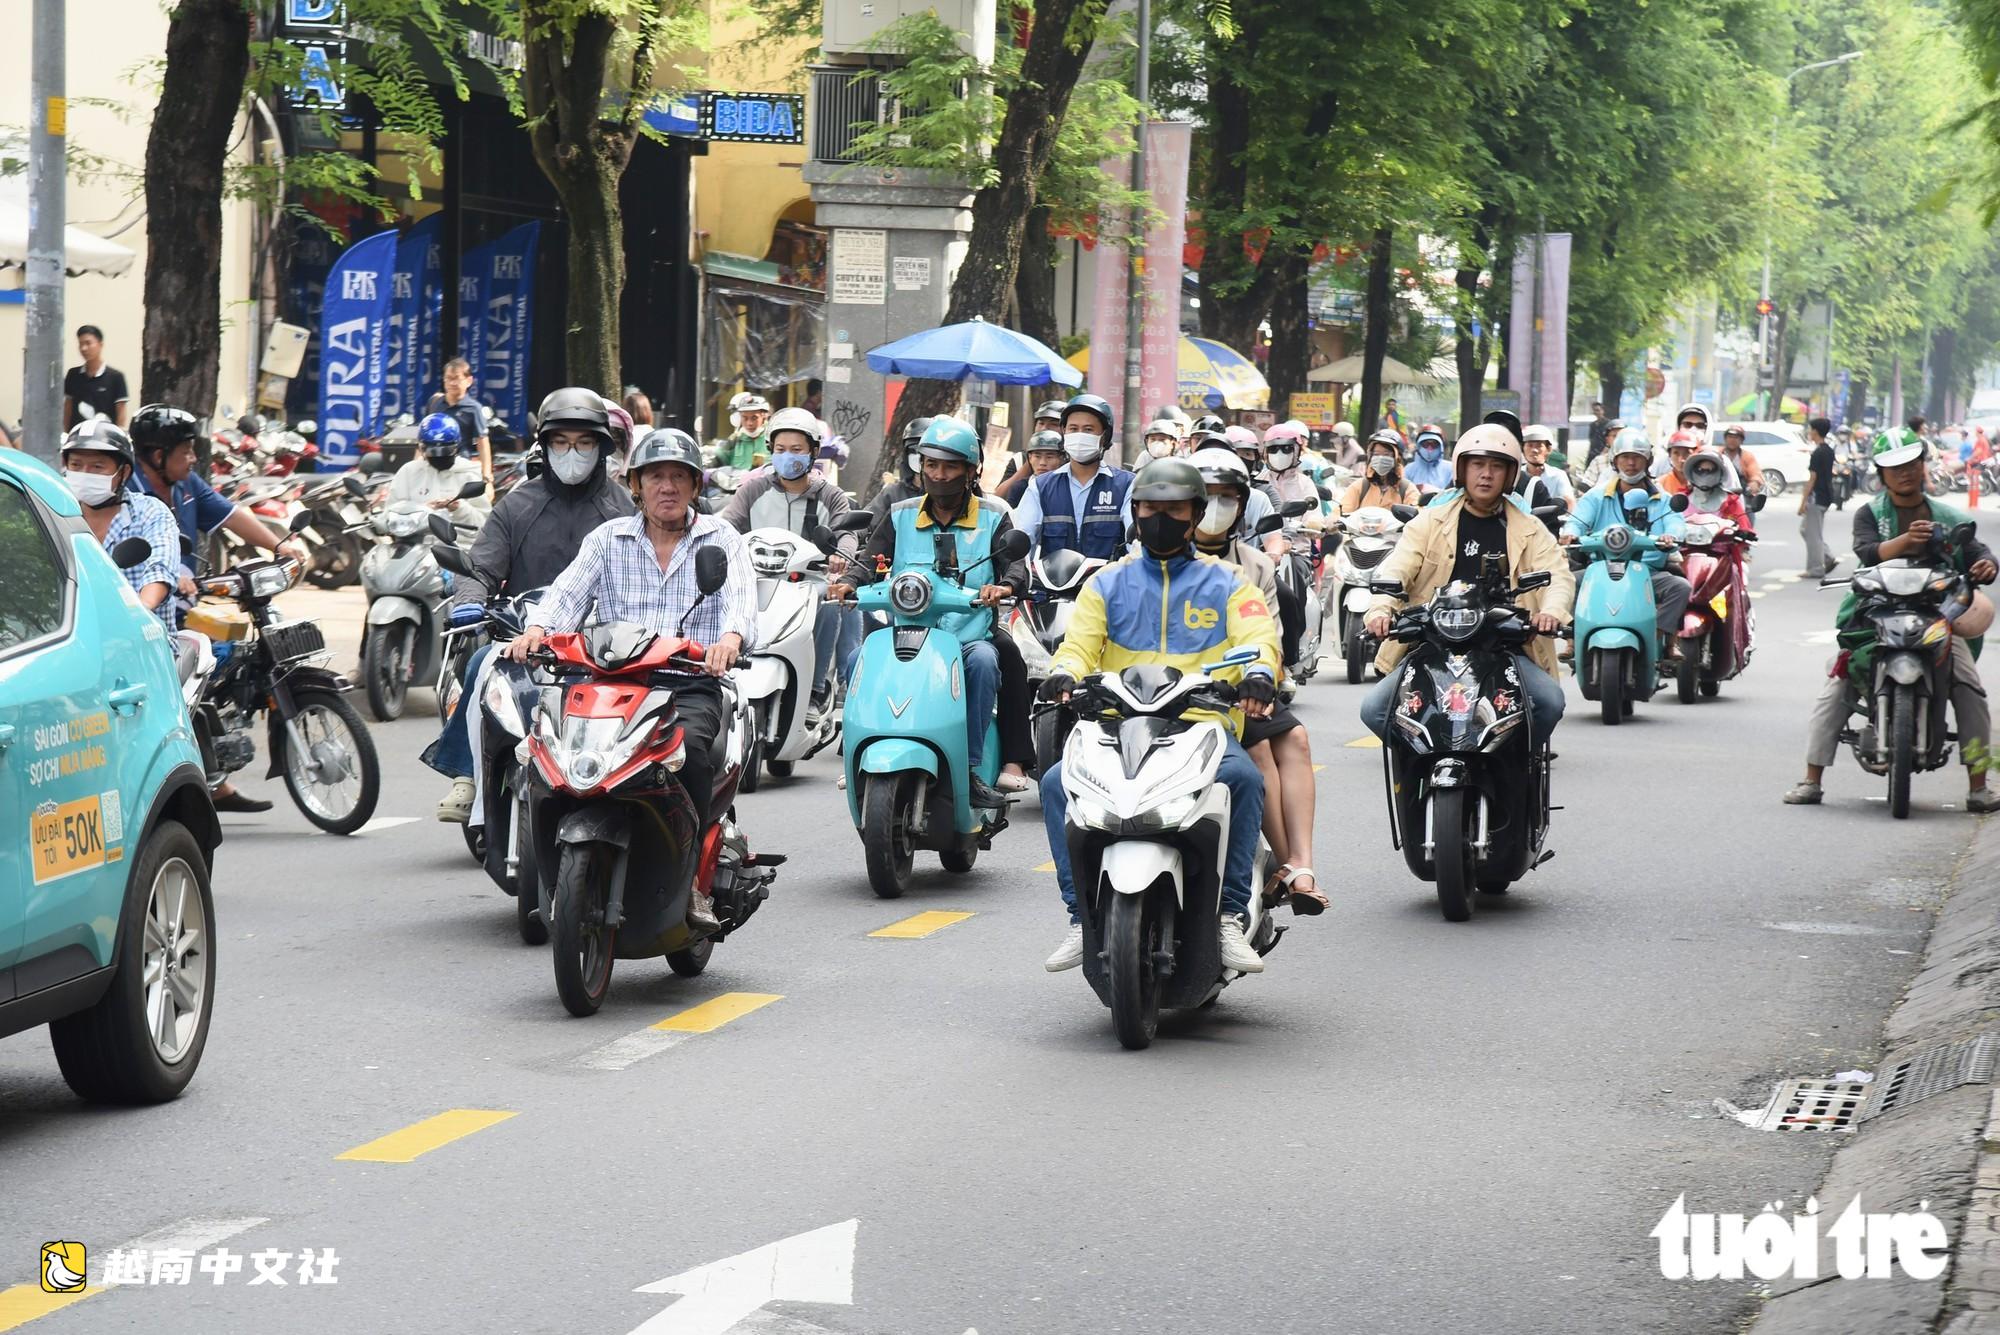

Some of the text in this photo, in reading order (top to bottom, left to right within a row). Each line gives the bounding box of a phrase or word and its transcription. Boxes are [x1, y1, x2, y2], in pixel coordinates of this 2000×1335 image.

[715, 99, 795, 137] BIDA
[369, 318, 384, 385] CENTRAL
[407, 315, 419, 373] CENTRAL
[514, 294, 528, 416] BILLIARDS CENTRAL
[320, 316, 368, 467] PURA
[1184, 600, 1219, 629] be
[34, 723, 50, 752] SÀI
[50, 719, 69, 747] GÒN
[44, 756, 59, 781] CHI
[64, 809, 102, 859] 50K
